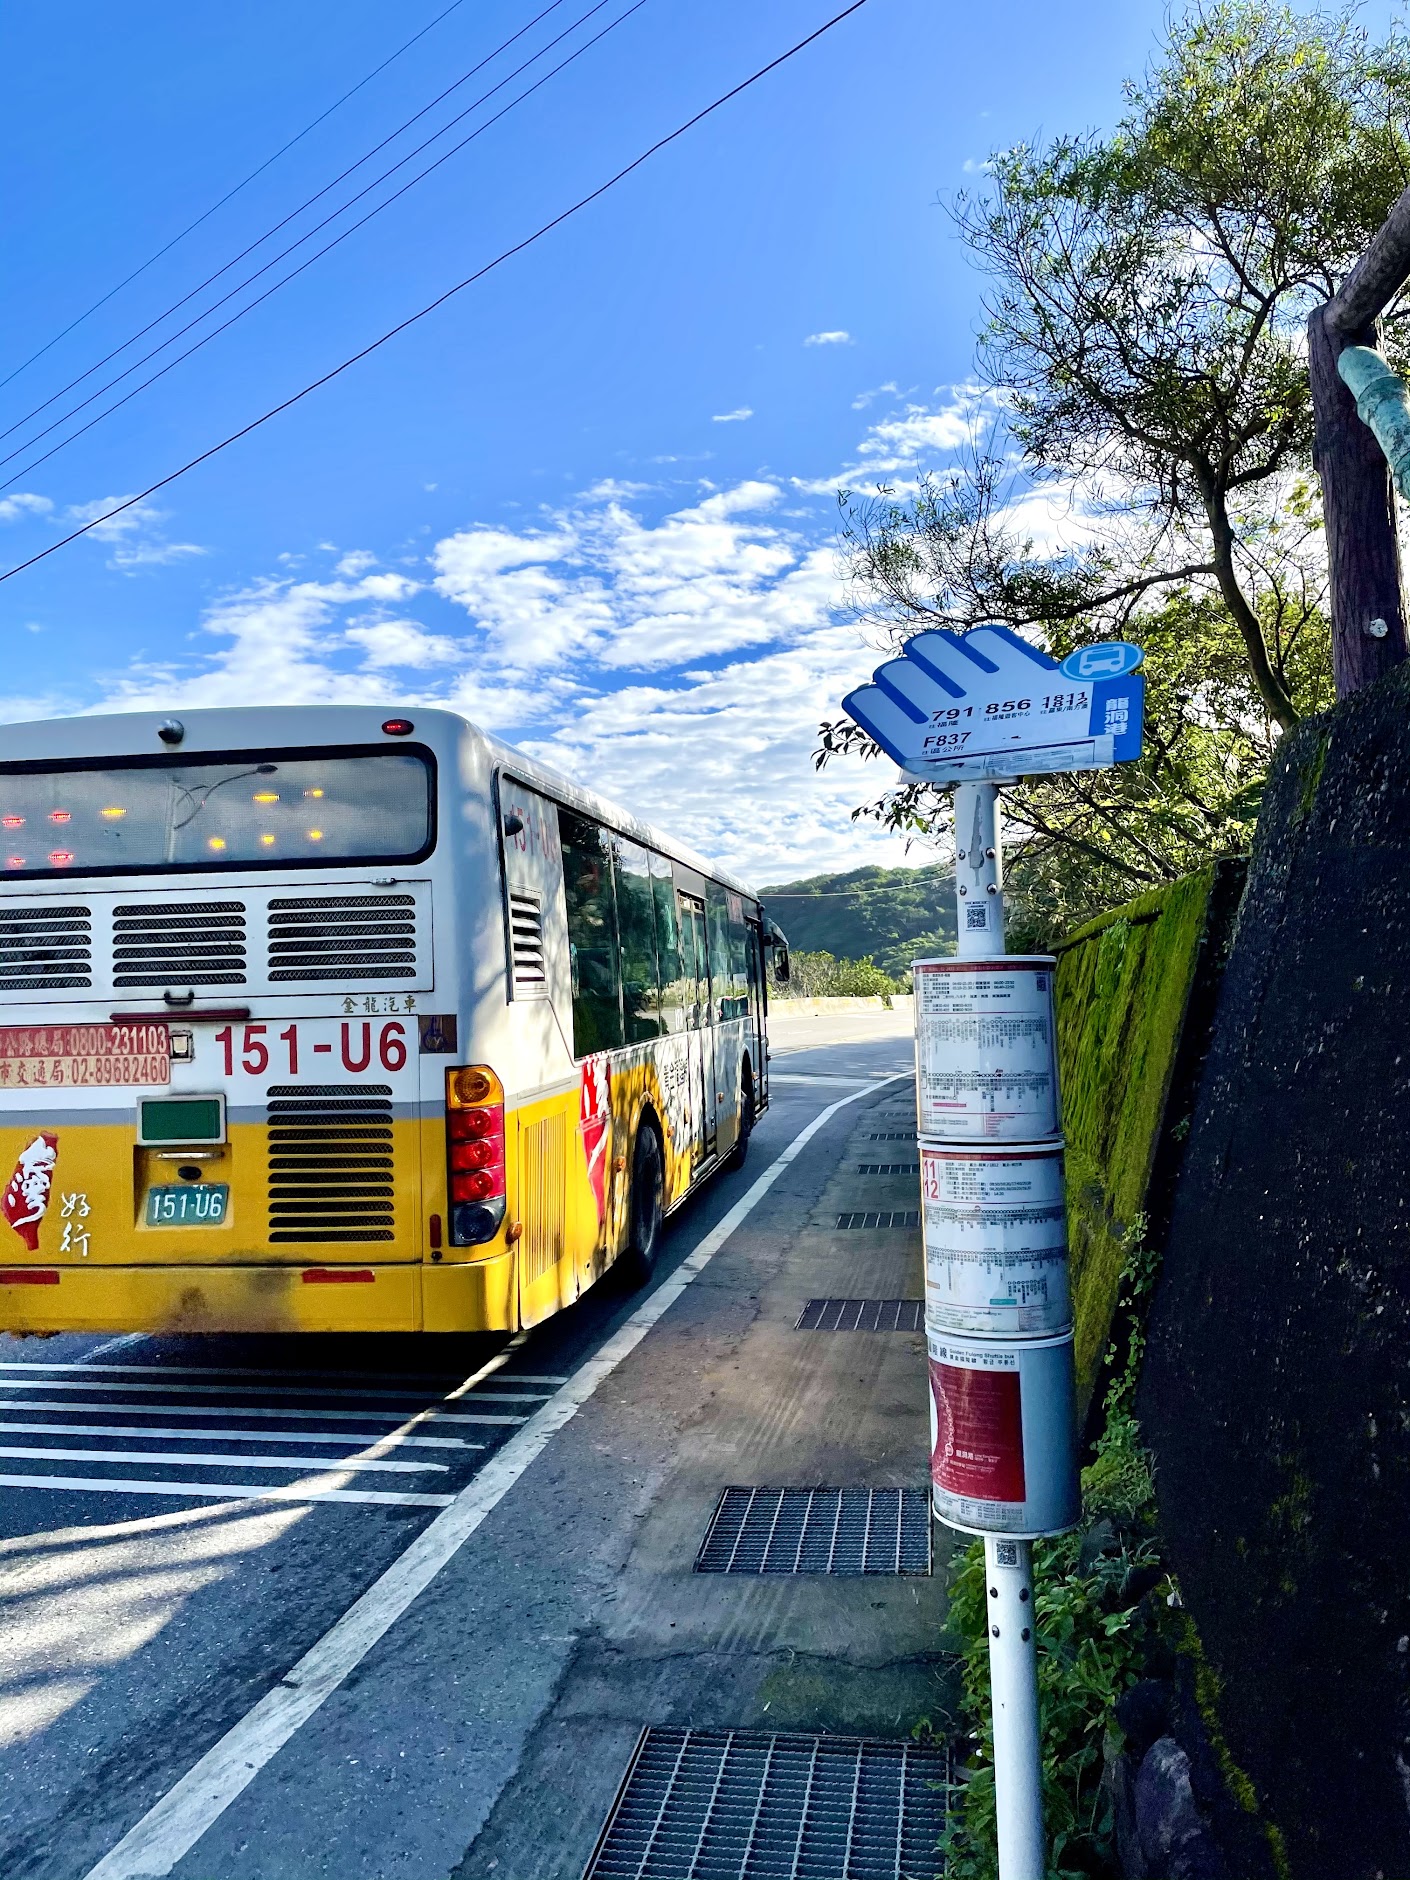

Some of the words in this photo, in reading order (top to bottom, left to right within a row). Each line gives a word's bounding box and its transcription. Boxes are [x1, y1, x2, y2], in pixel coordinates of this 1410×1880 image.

[932, 706, 973, 721] 791
[985, 699, 1031, 714] 856
[924, 732, 971, 748] F837
[341, 995, 416, 1013] 金龍汽車
[215, 1021, 407, 1076] 151-U6
[153, 1193, 222, 1219] 151-U6
